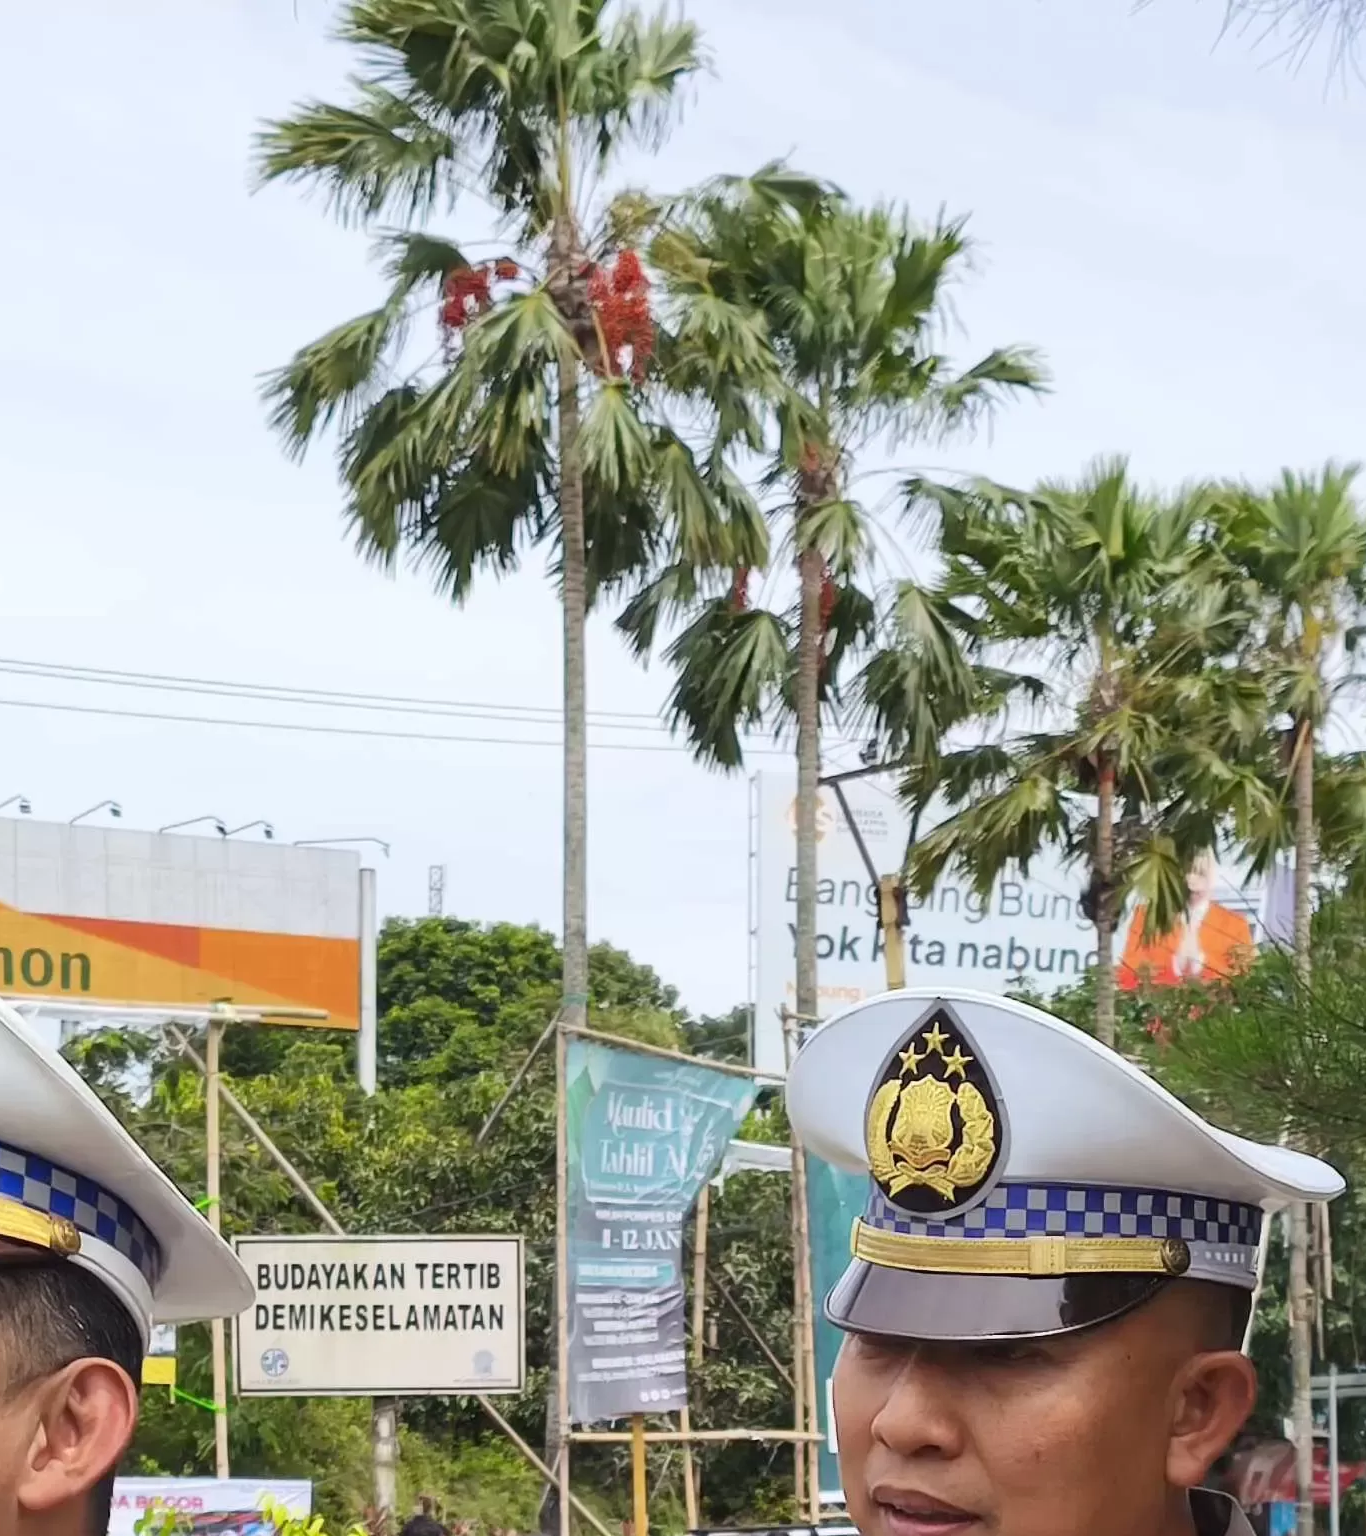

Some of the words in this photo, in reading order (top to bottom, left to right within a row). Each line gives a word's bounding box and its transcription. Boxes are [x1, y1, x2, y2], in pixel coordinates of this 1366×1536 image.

[871, 928, 945, 967] kta
[257, 1263, 406, 1291] BUDAYAKAN
[415, 1263, 502, 1290] TERTIB
